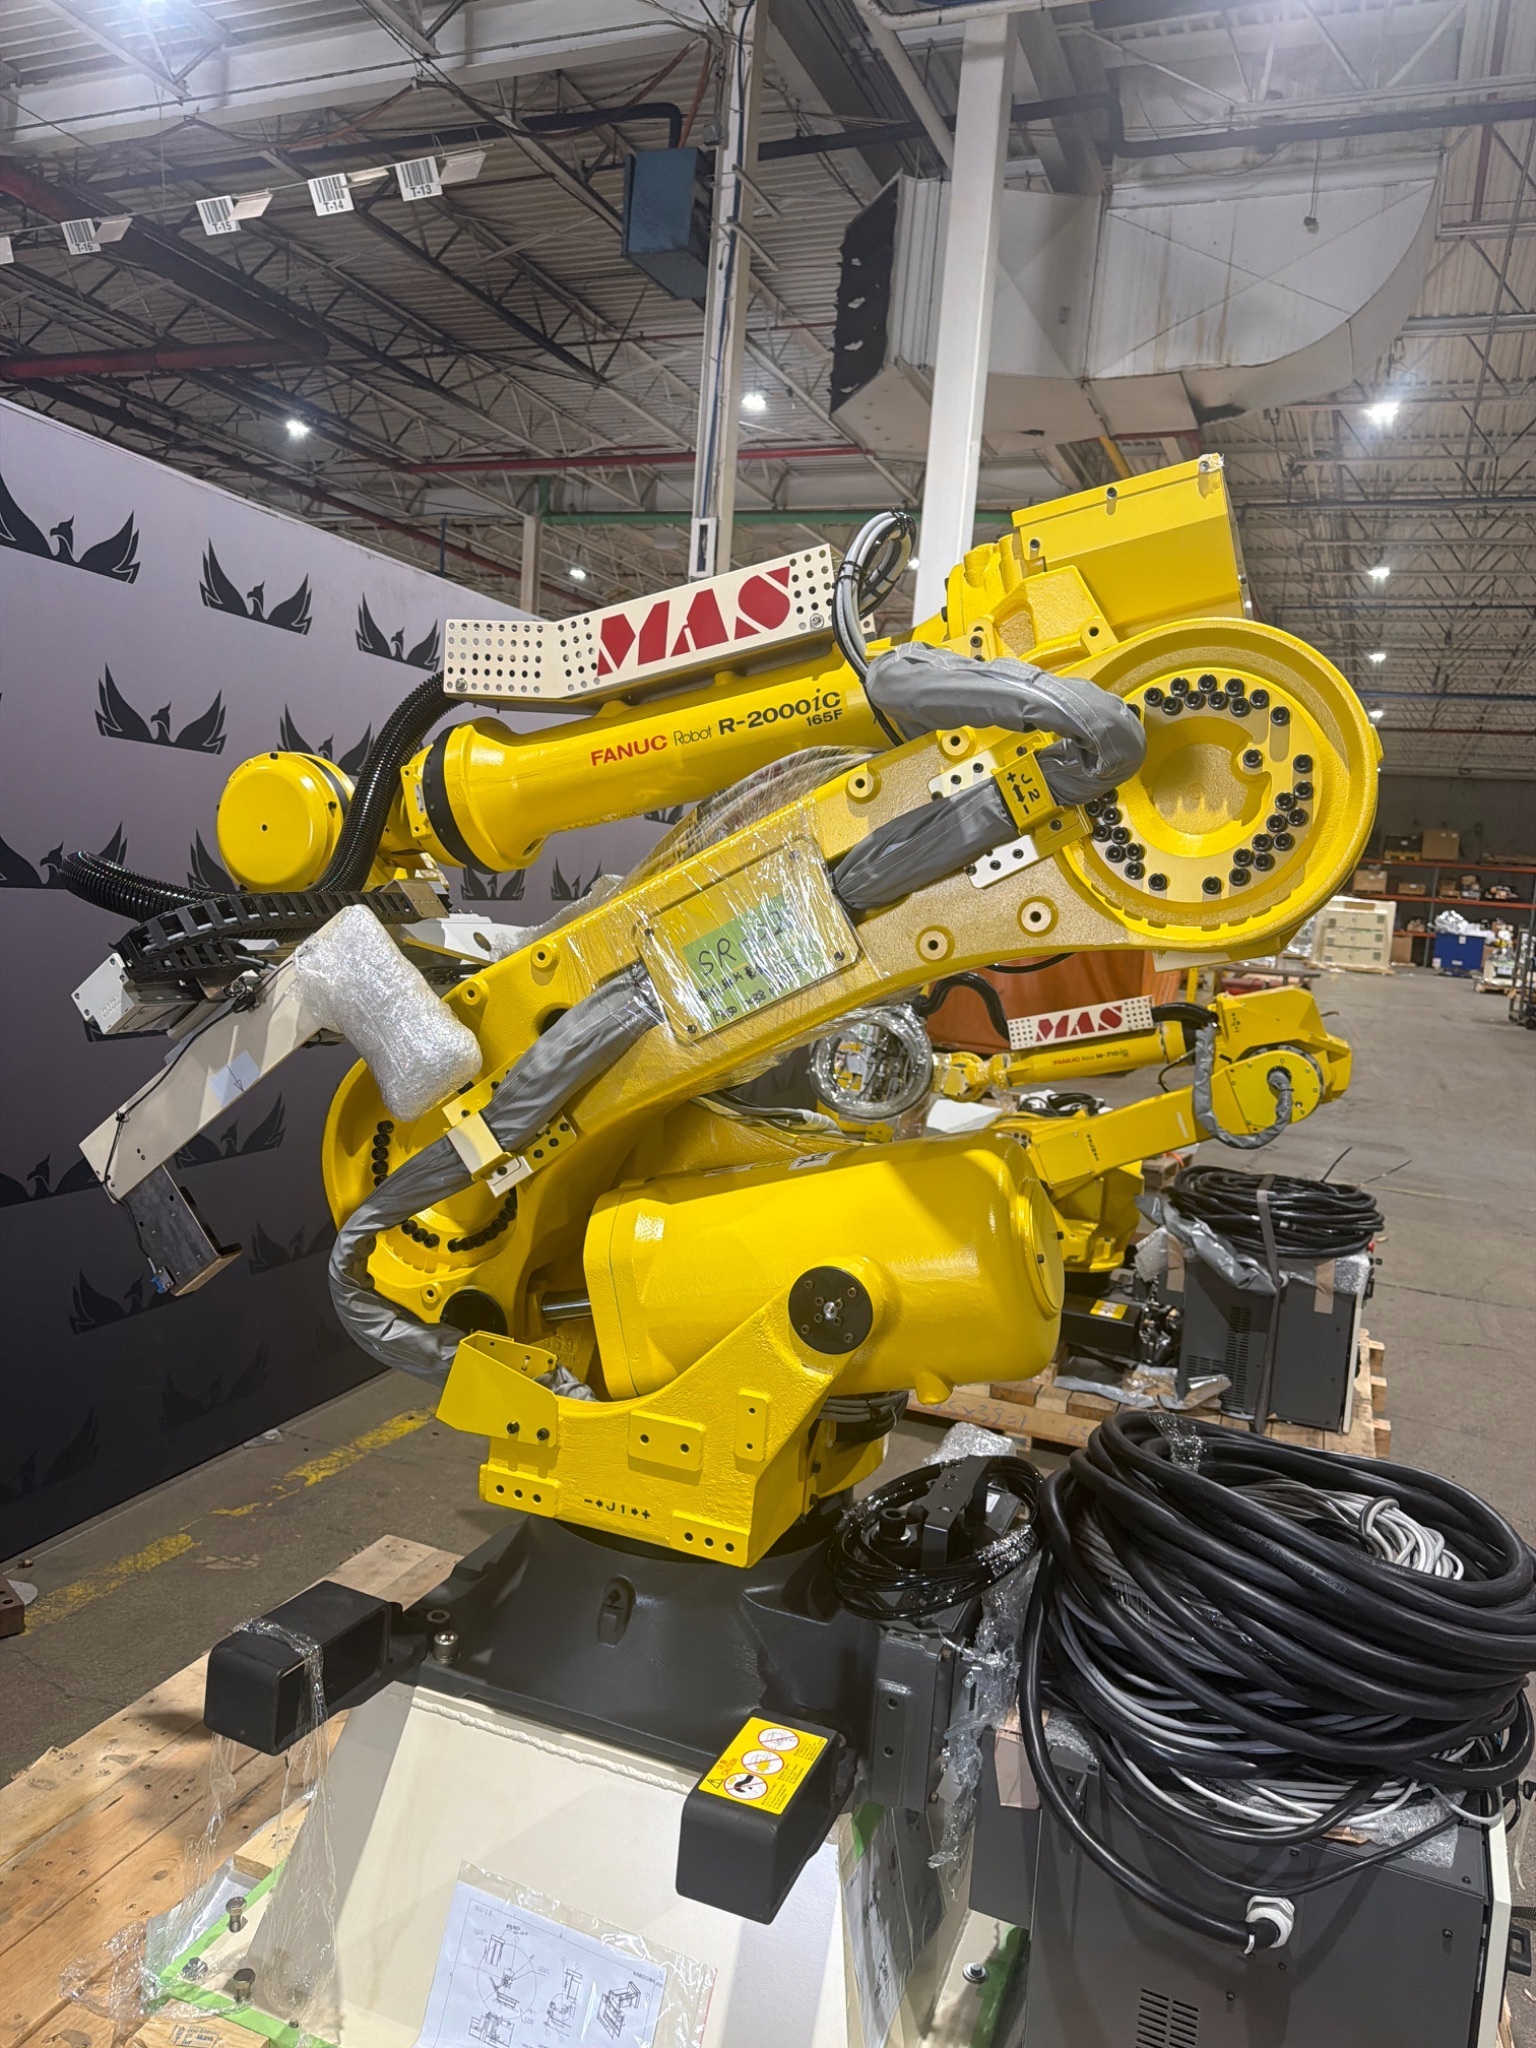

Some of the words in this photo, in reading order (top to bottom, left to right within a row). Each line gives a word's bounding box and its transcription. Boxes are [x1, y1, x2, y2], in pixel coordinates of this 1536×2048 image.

[409, 184, 432, 197] T-13
[322, 200, 345, 213] T-14
[211, 221, 233, 232] T-15
[597, 566, 790, 677] MAS
[806, 709, 843, 727] 165F
[591, 734, 668, 767] FANUC
[673, 725, 713, 747] Robot
[1035, 1005, 1123, 1042] MAS
